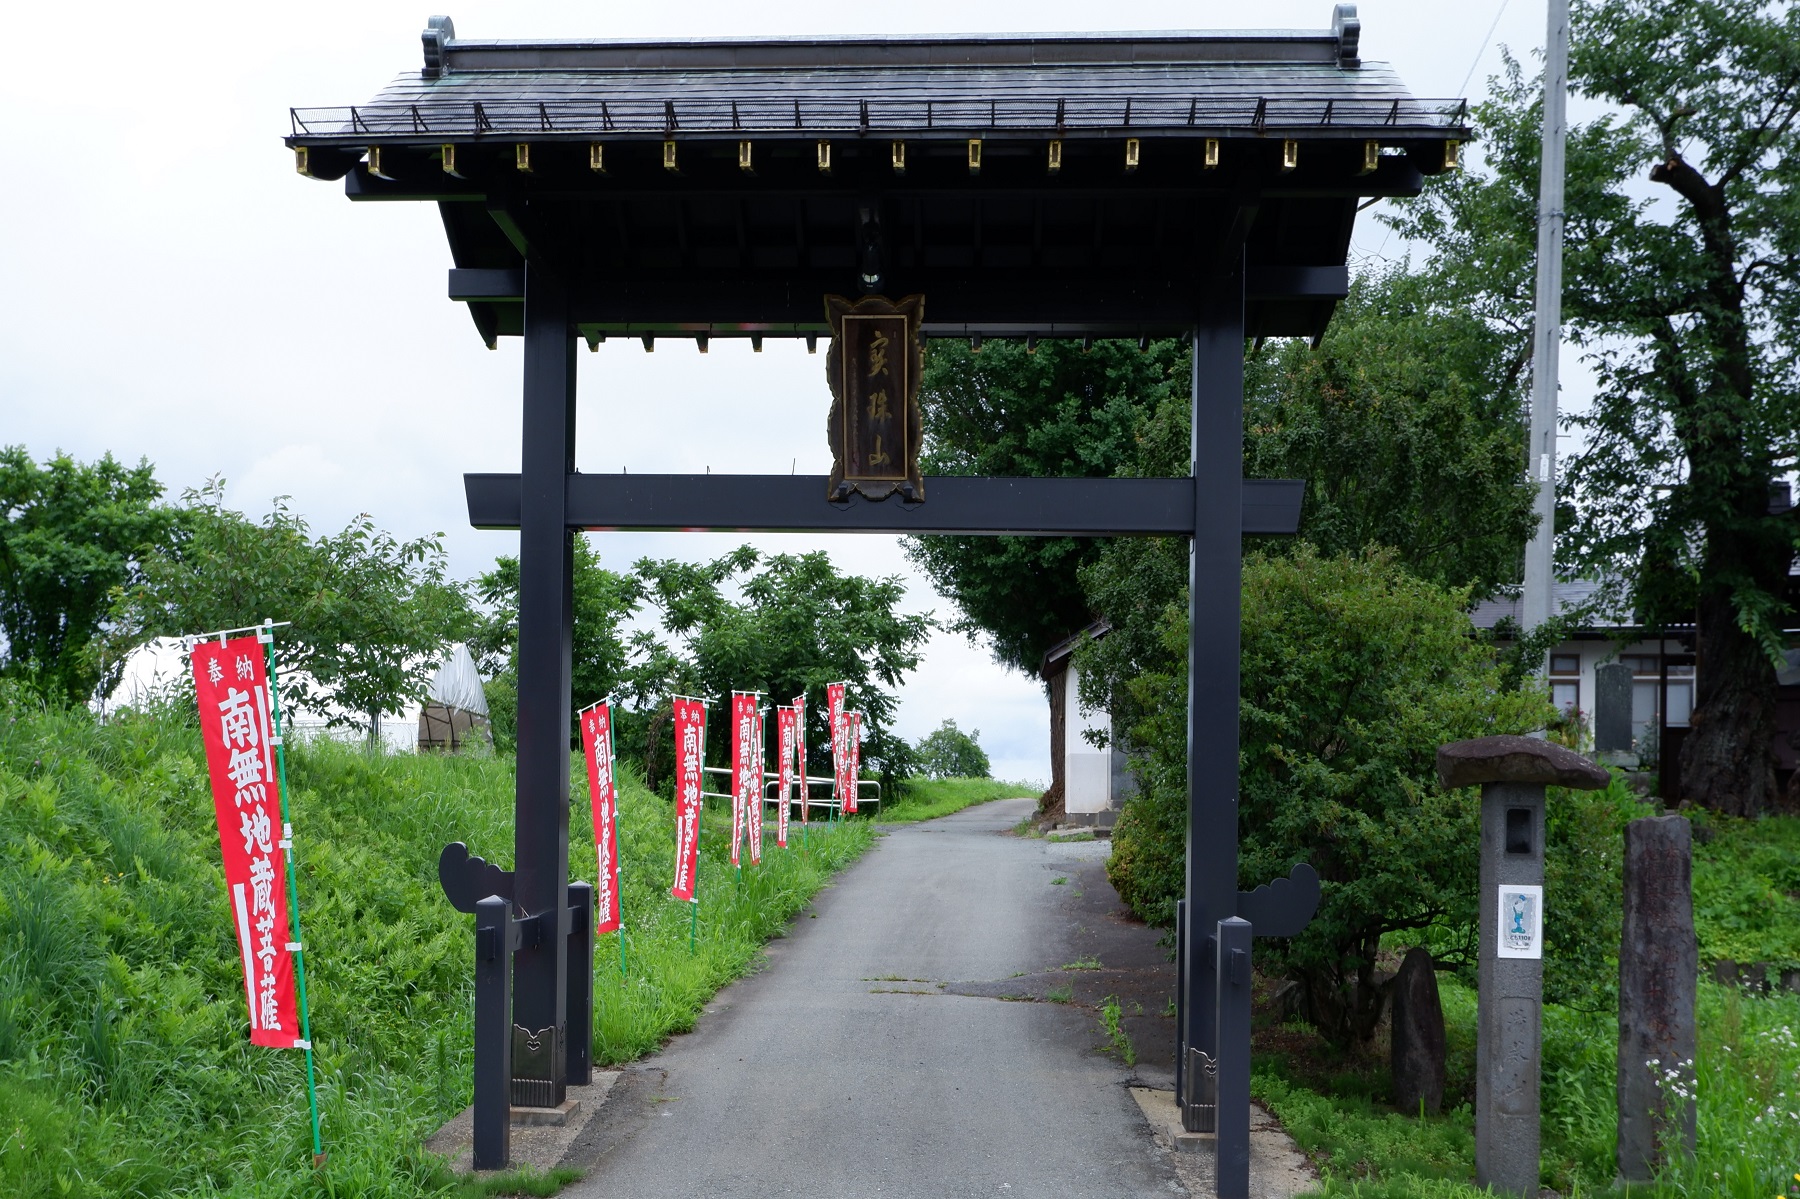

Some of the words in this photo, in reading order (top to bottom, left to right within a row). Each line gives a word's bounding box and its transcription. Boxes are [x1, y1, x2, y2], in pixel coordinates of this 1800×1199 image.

[207, 655, 255, 687] 奉納
[588, 714, 607, 735] 奉納
[679, 707, 700, 723] 奉納
[218, 687, 282, 1031] 南無地蔵菩薩
